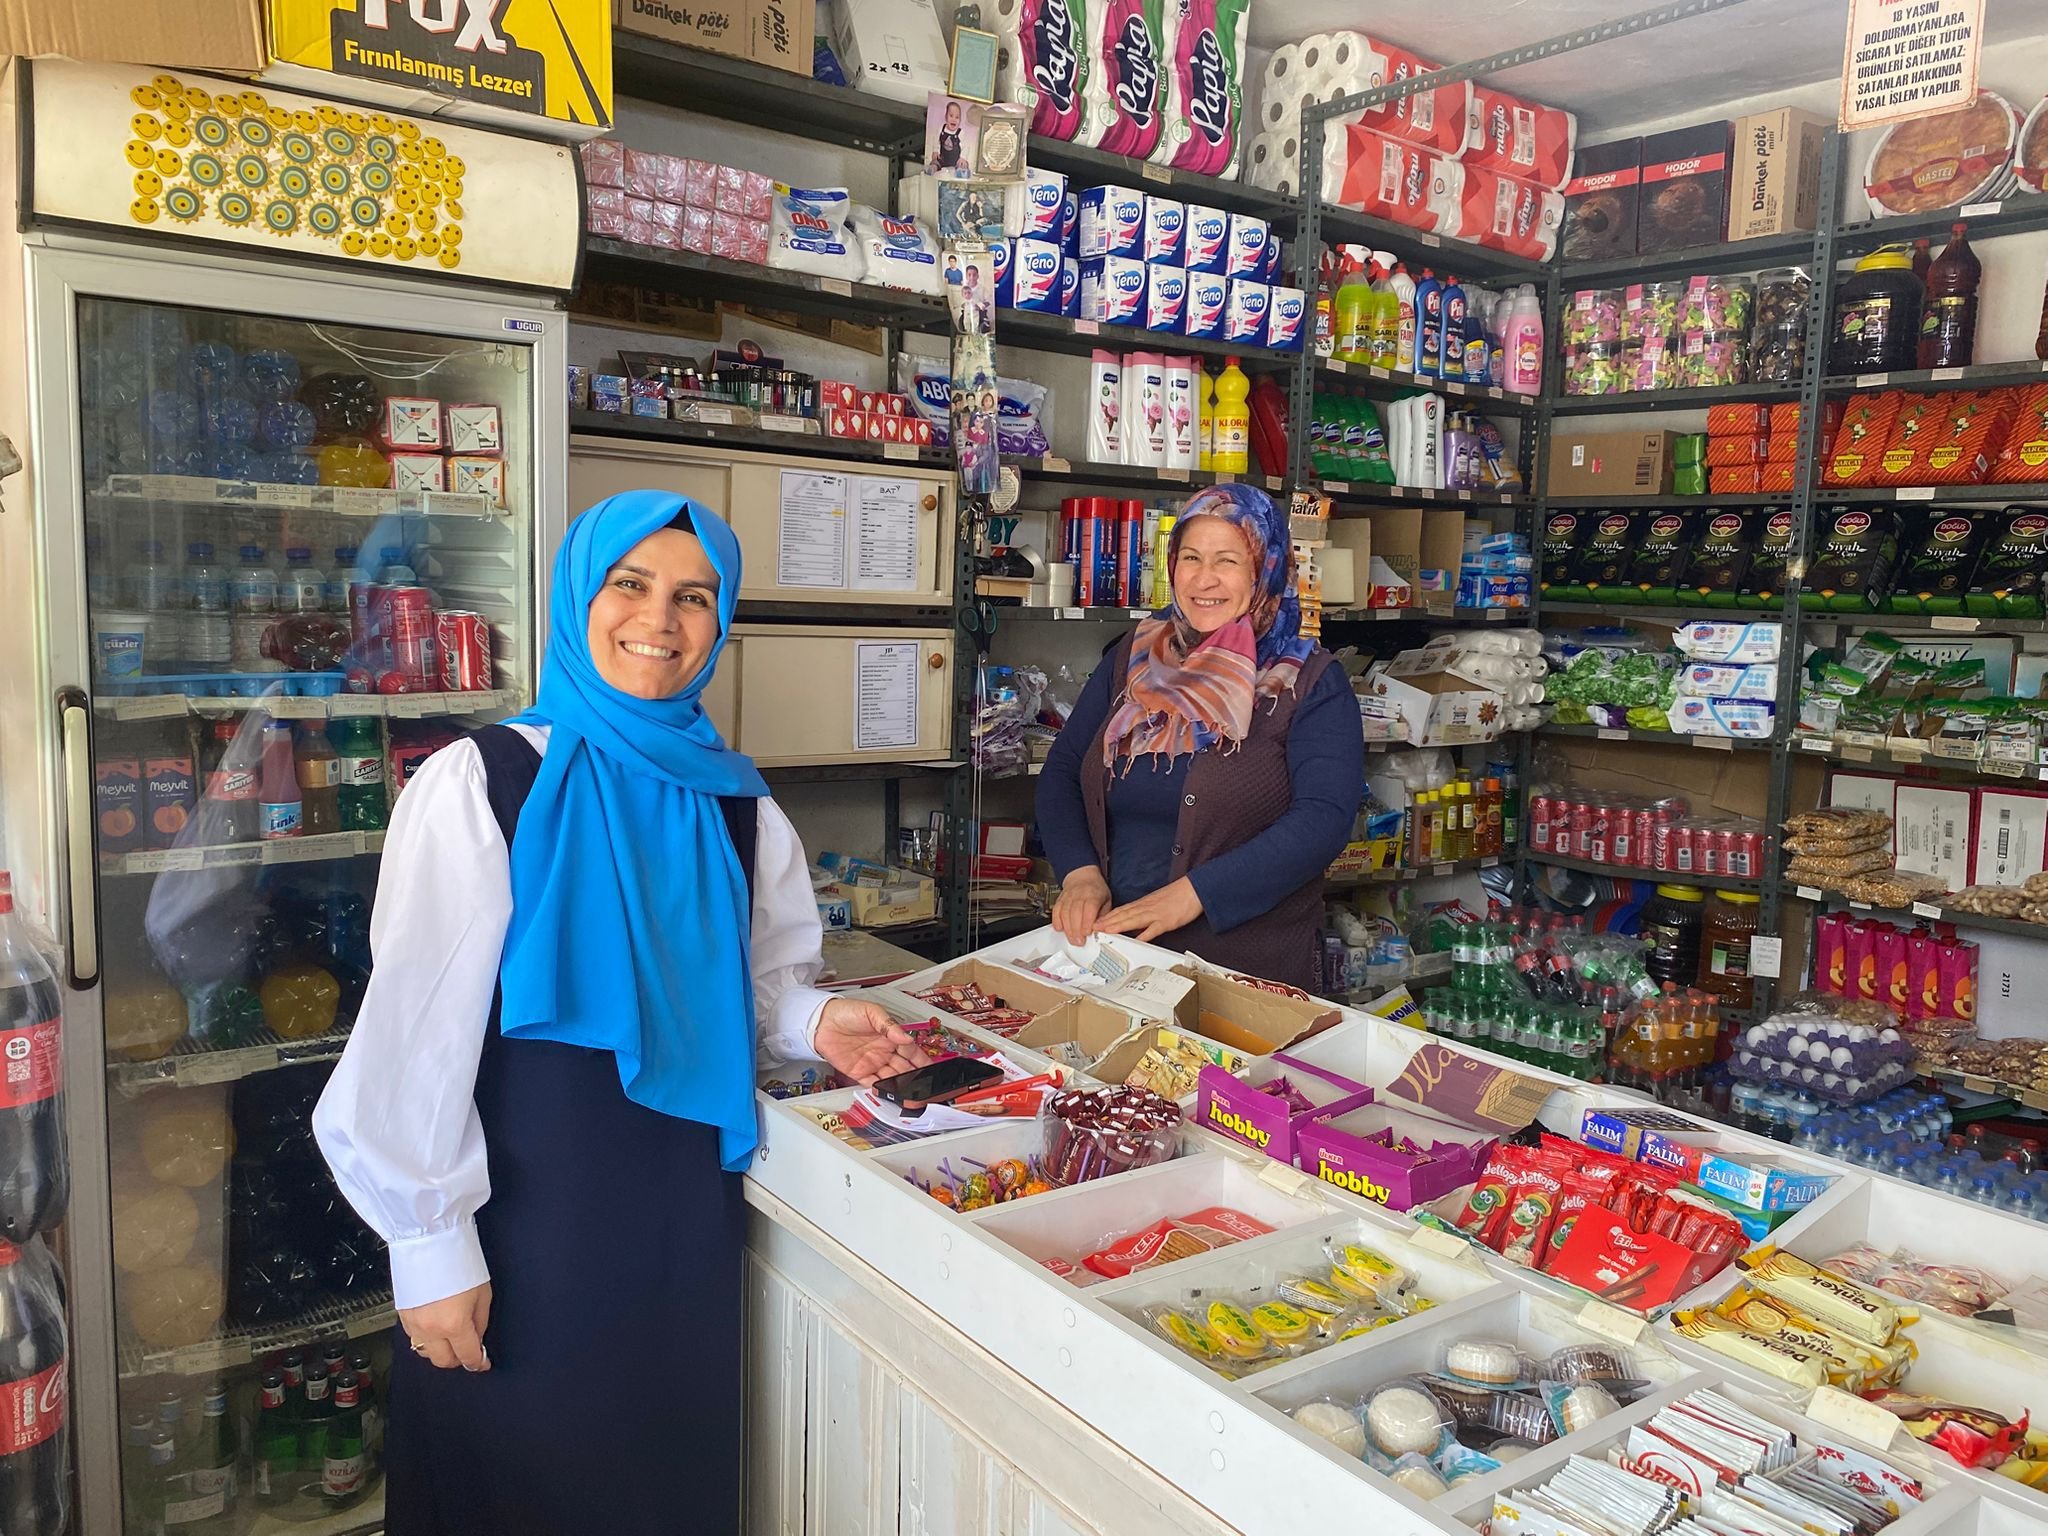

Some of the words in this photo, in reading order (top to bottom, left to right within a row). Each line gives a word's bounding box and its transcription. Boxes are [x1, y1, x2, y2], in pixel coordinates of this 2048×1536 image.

[696, 11, 730, 30] pöti
[1893, 9, 1903, 23] 18
[1906, 1, 1940, 19] YAŞINI
[702, 28, 723, 38] mini
[768, 5, 790, 55] pöti
[1864, 12, 1965, 46] DOLDURMAYANLARA
[1856, 45, 1891, 64] SİGARA
[1894, 41, 1906, 56] VE
[1909, 35, 1936, 53] DİĞER
[1940, 26, 1972, 45] TÜTÜN
[344, 39, 464, 89] Fırınlanmış
[469, 65, 533, 98] Lezzet
[892, 61, 911, 74] 48
[1115, 16, 1153, 120] Papia
[1857, 56, 1903, 79] ÜRÜNLERİ
[1190, 32, 1223, 138] Papia
[1858, 73, 1909, 95] SATANLAR
[1911, 62, 1962, 84] HAKKINDA
[1855, 94, 1887, 112] YASAL
[1889, 89, 1919, 106] İŞLEM
[1921, 79, 1963, 98] YAPILIR.
[1753, 125, 1771, 157] pöti
[1665, 160, 1701, 174] HODOR
[1584, 173, 1617, 187] HODOR
[1753, 160, 1769, 212] Dankek
[1031, 184, 1058, 203] Teno
[791, 212, 829, 230] OMO
[1114, 203, 1140, 220] Teno
[1155, 212, 1180, 229] Teno
[1196, 220, 1222, 237] Teno
[1238, 228, 1262, 245] Teno
[1026, 254, 1055, 271] Teno
[1115, 272, 1141, 288] Teno
[1157, 280, 1182, 296] Teno
[1198, 287, 1222, 303] Teno
[1241, 294, 1264, 310] Teno
[1279, 301, 1301, 315] Teno
[104, 639, 139, 650] gürler
[97, 782, 137, 797] Meyvit
[150, 779, 189, 794] Meyvit
[2001, 972, 2011, 999] 21731
[1208, 1101, 1272, 1149] hobby
[1586, 1120, 1622, 1144] FALIM
[1319, 1147, 1345, 1166] ÜLKER
[1647, 1143, 1686, 1167] FALIM
[1317, 1160, 1392, 1205] hobby
[1706, 1166, 1747, 1190] FALIM
[1560, 1195, 1587, 1210] Jello
[1809, 1276, 1880, 1314] Dankek
[1257, 1303, 1300, 1328] SOFT
